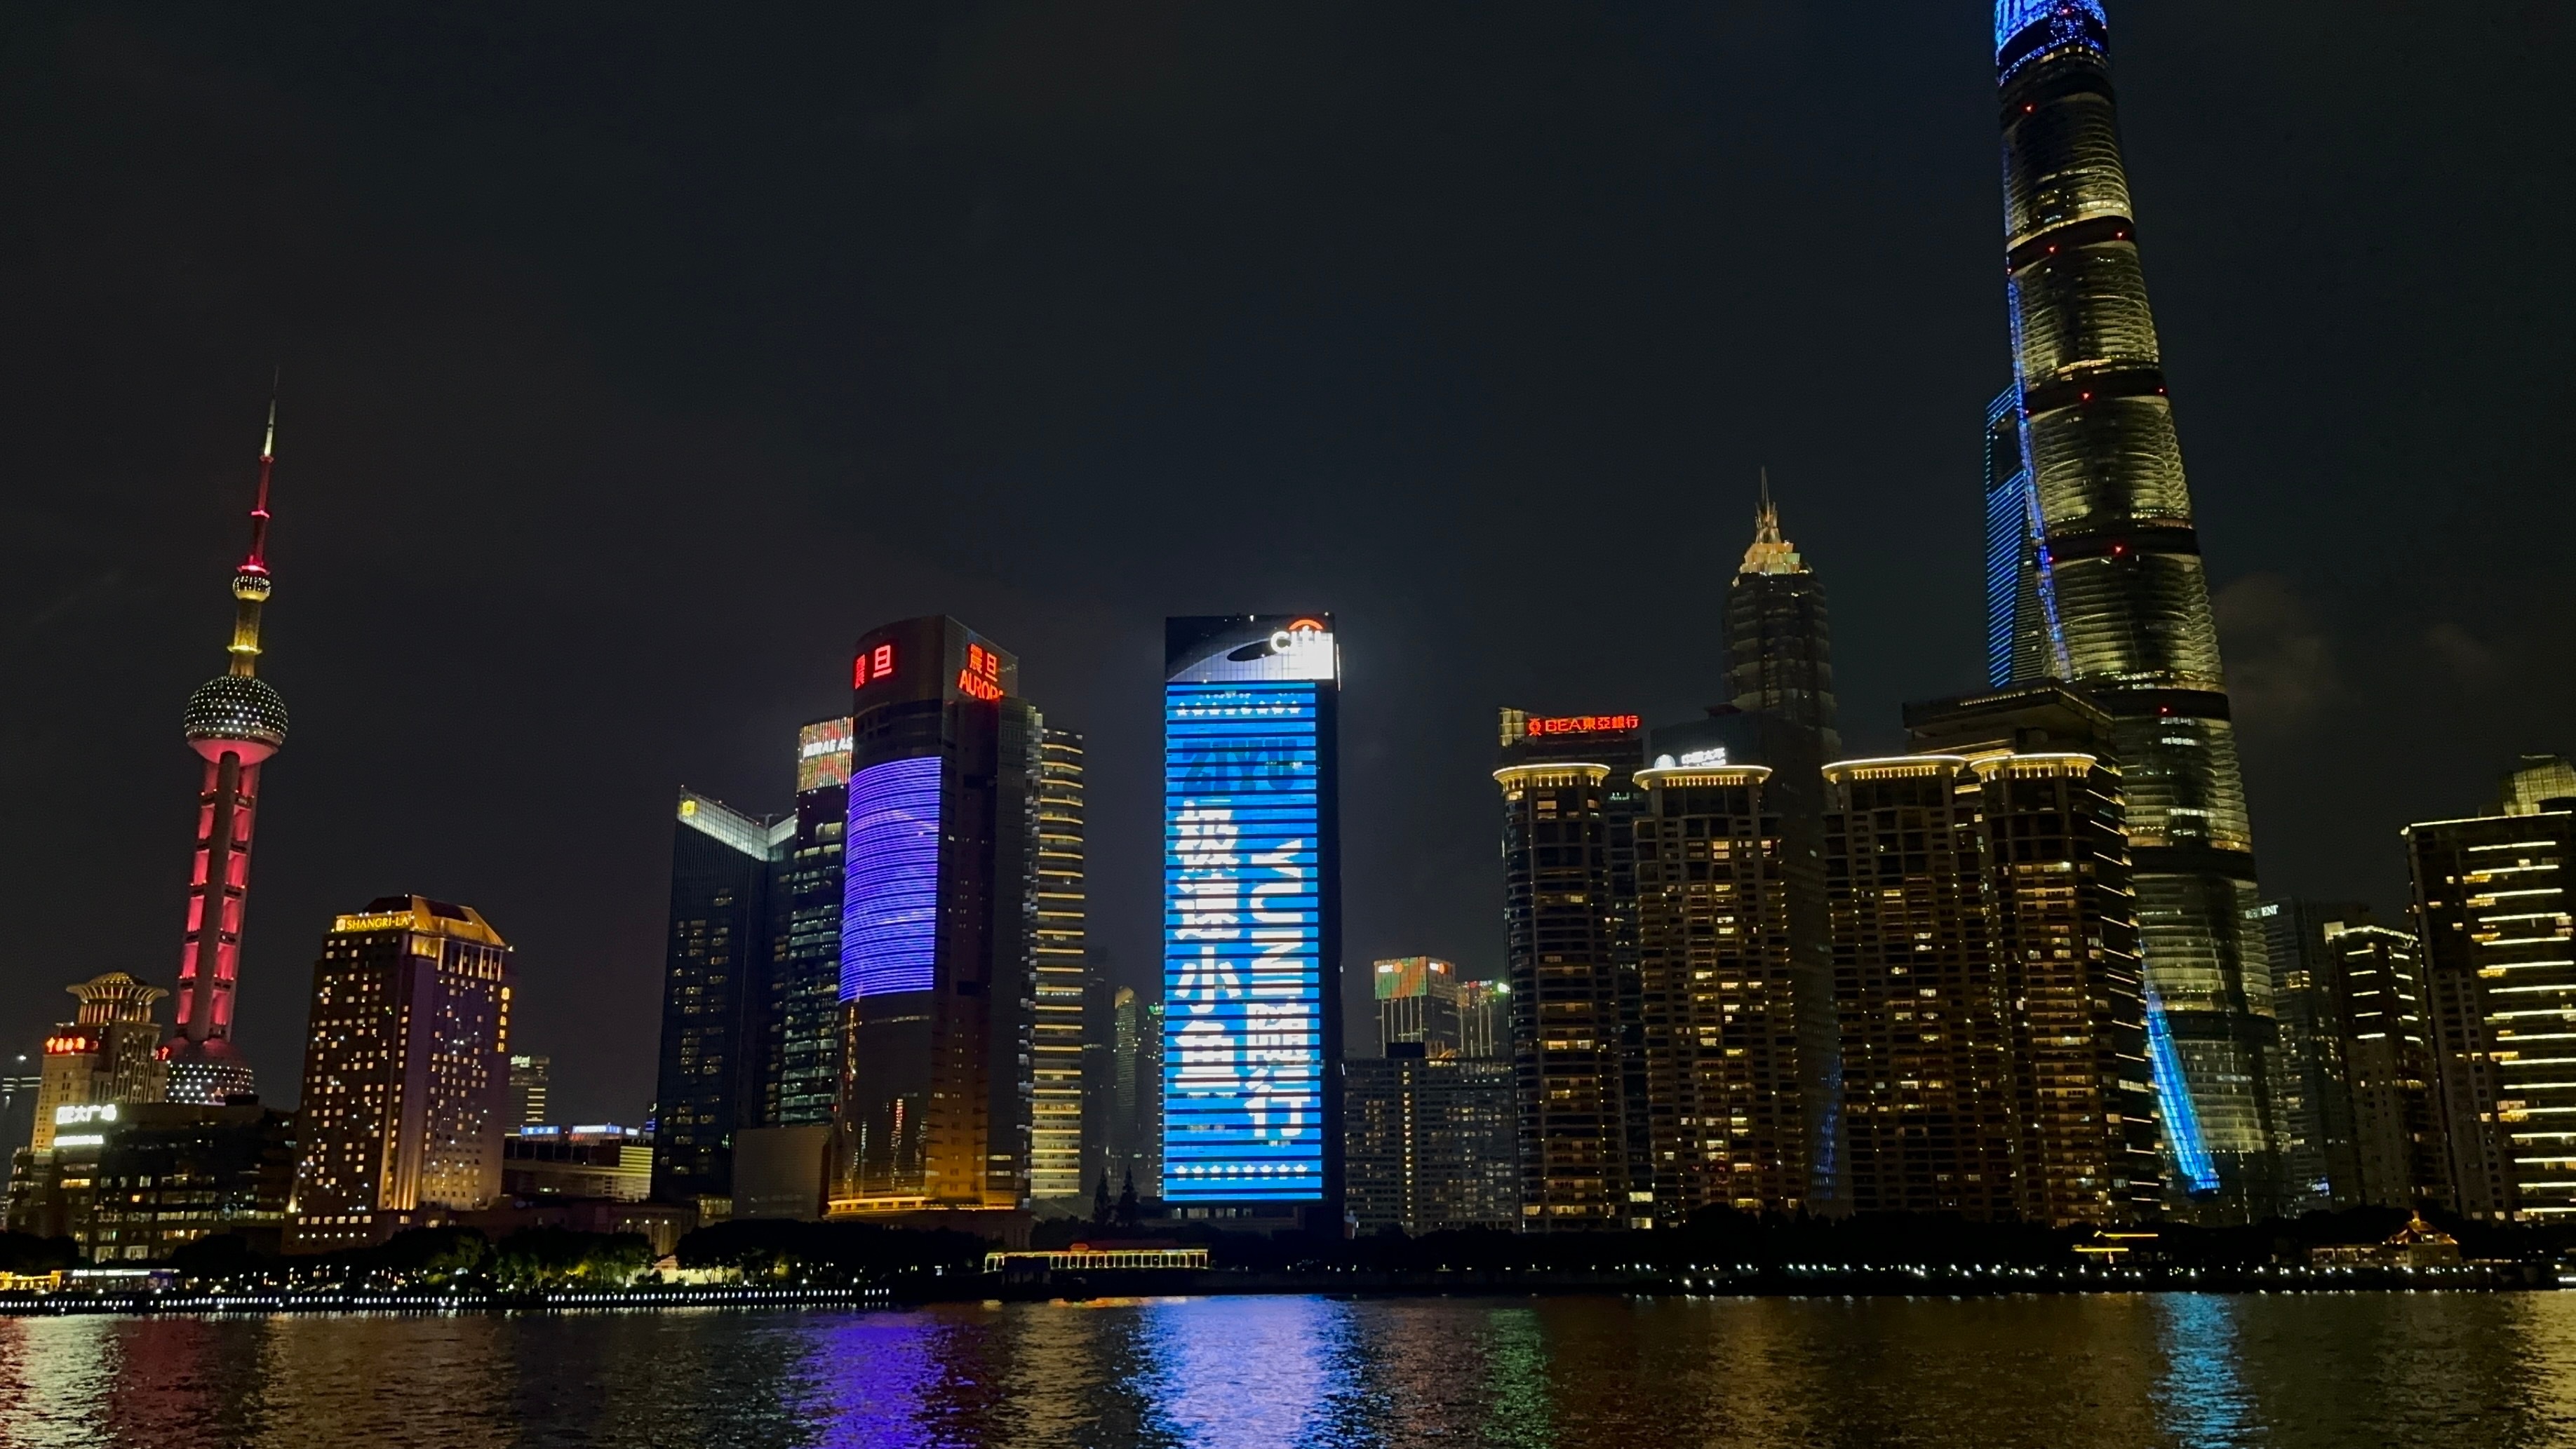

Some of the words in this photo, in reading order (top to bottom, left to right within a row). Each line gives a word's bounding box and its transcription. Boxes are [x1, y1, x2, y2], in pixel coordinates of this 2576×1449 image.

[854, 645, 893, 690] 震旦
[969, 643, 998, 682] 震旦
[1545, 718, 1581, 732] BEA
[2246, 904, 2279, 919] RENT
[1175, 800, 1241, 1089] 极速小鱼
